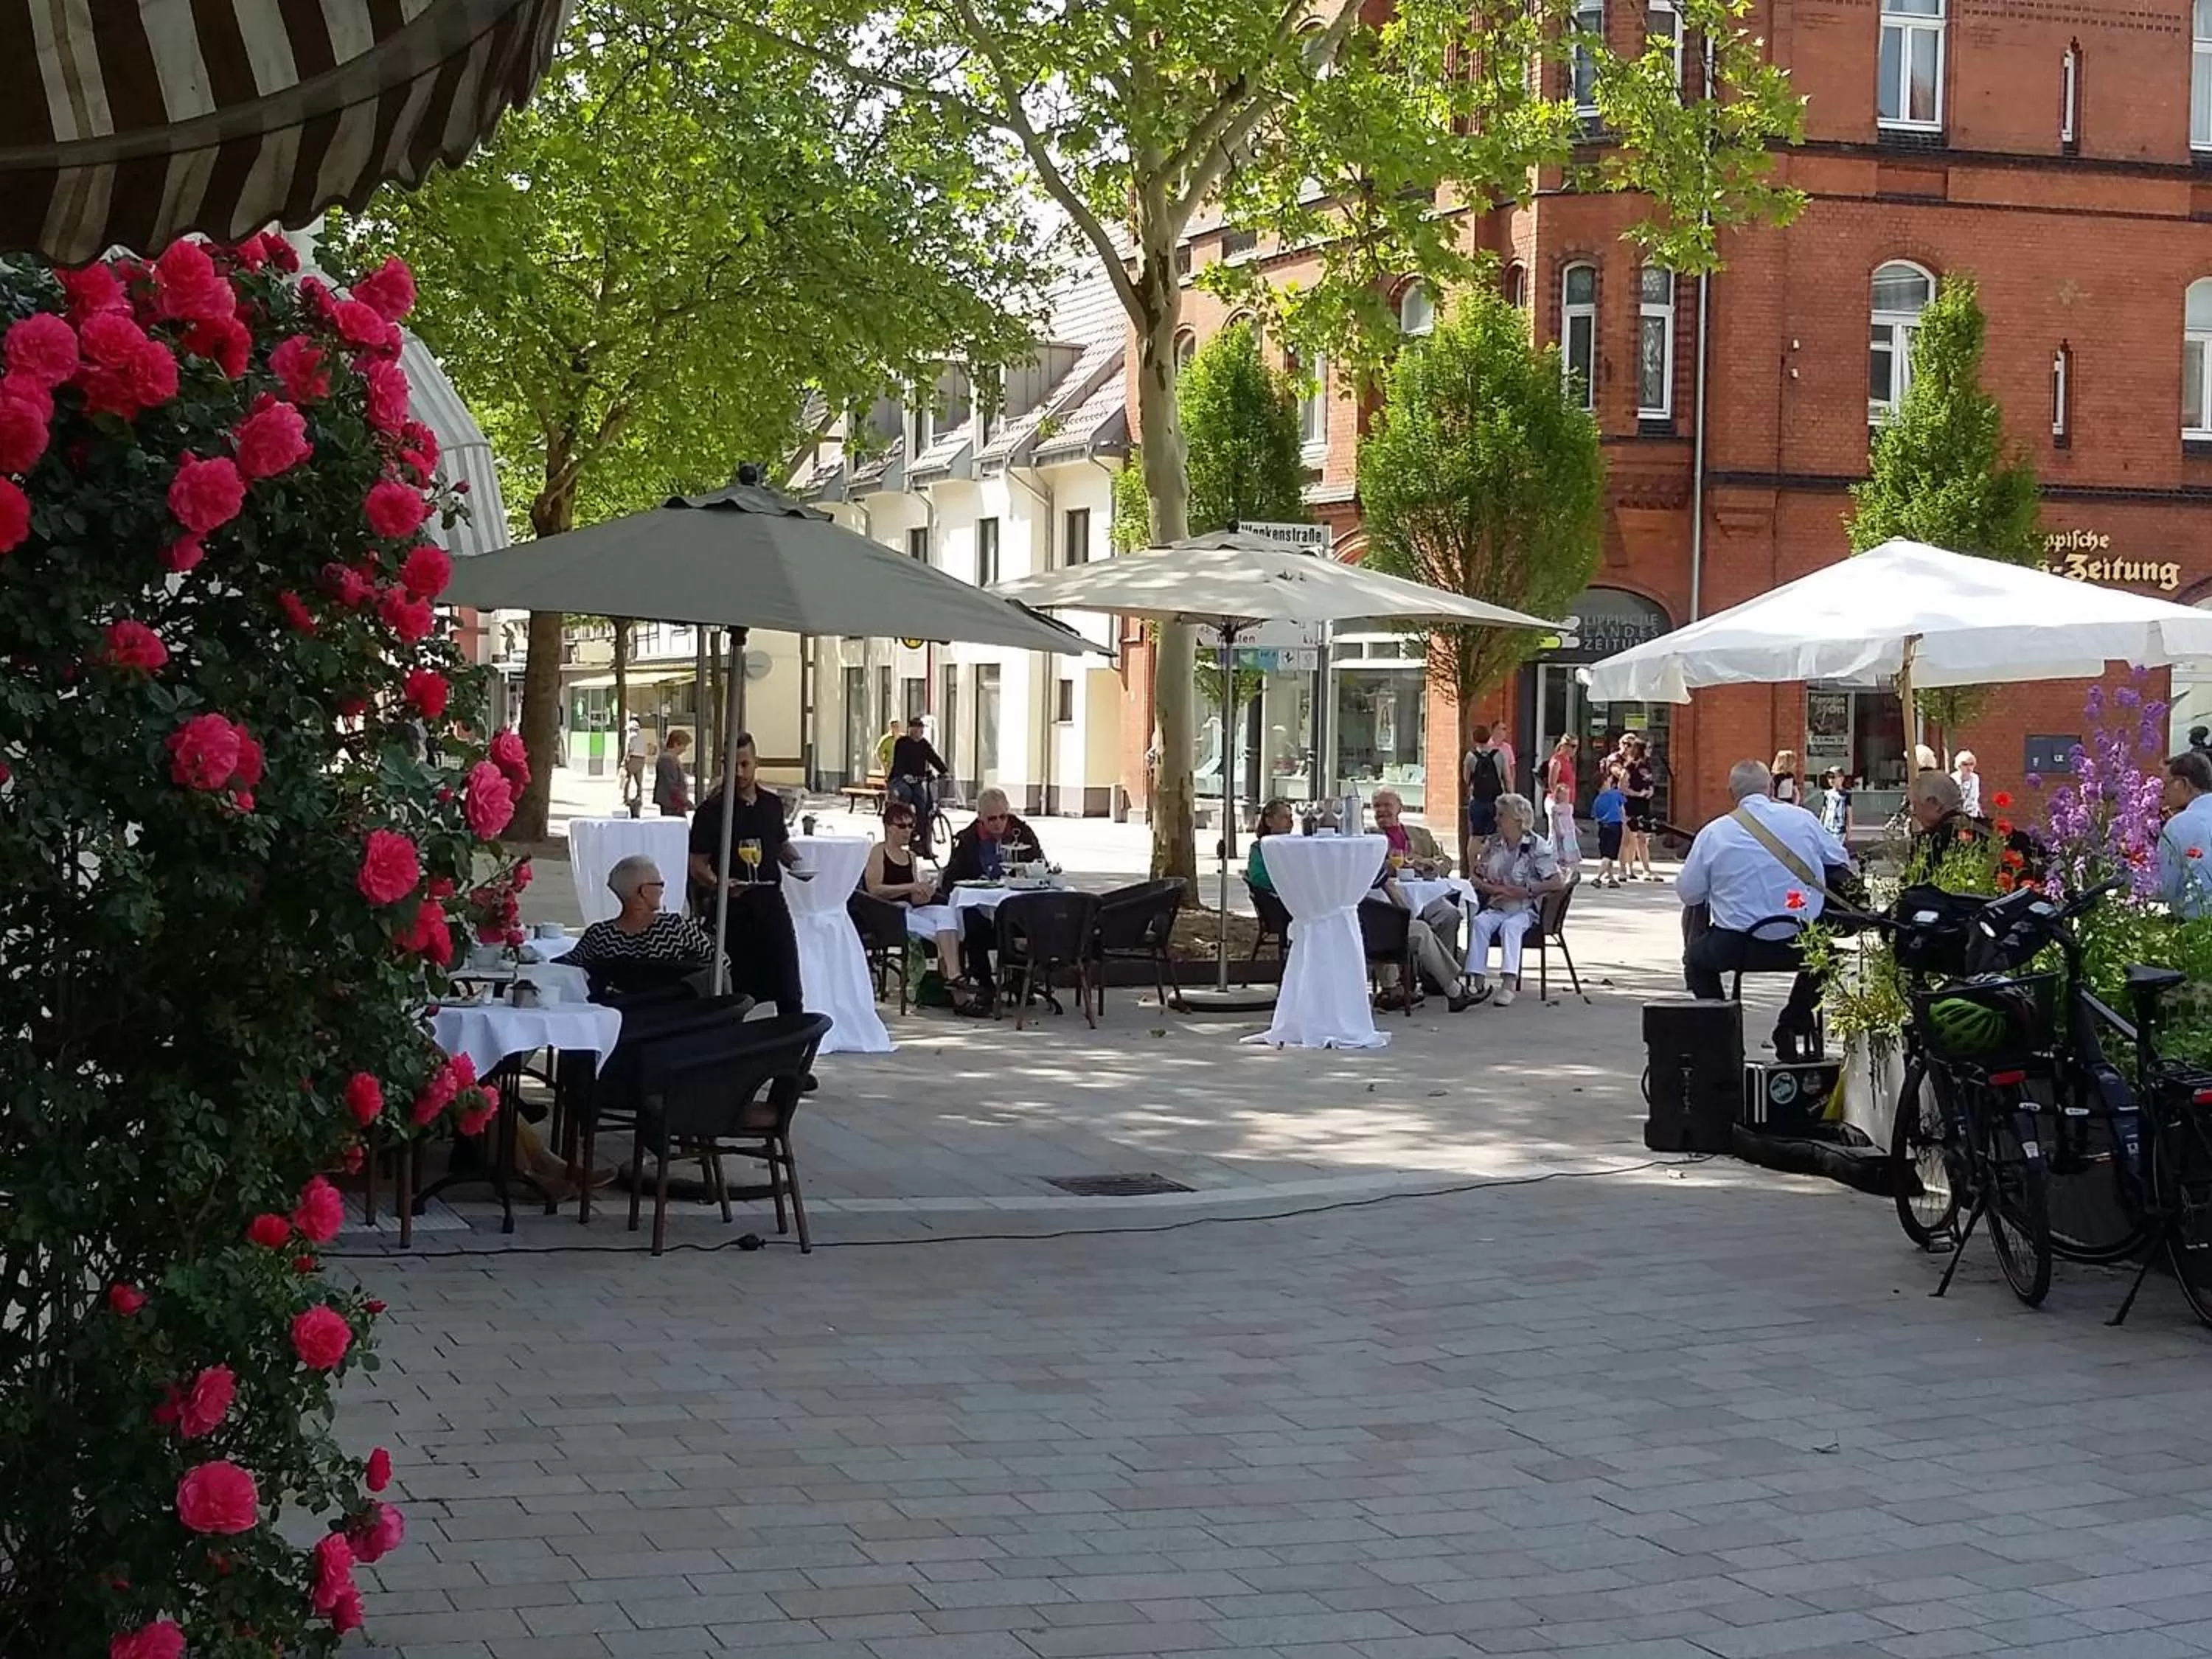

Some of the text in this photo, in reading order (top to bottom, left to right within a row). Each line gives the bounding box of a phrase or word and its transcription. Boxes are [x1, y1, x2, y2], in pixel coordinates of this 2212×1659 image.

[2043, 529, 2110, 553] ppische
[1584, 613, 1659, 626] LIPPISCHE
[1584, 626, 1660, 638] LANDES
[1584, 637, 1645, 651] ZEITU
